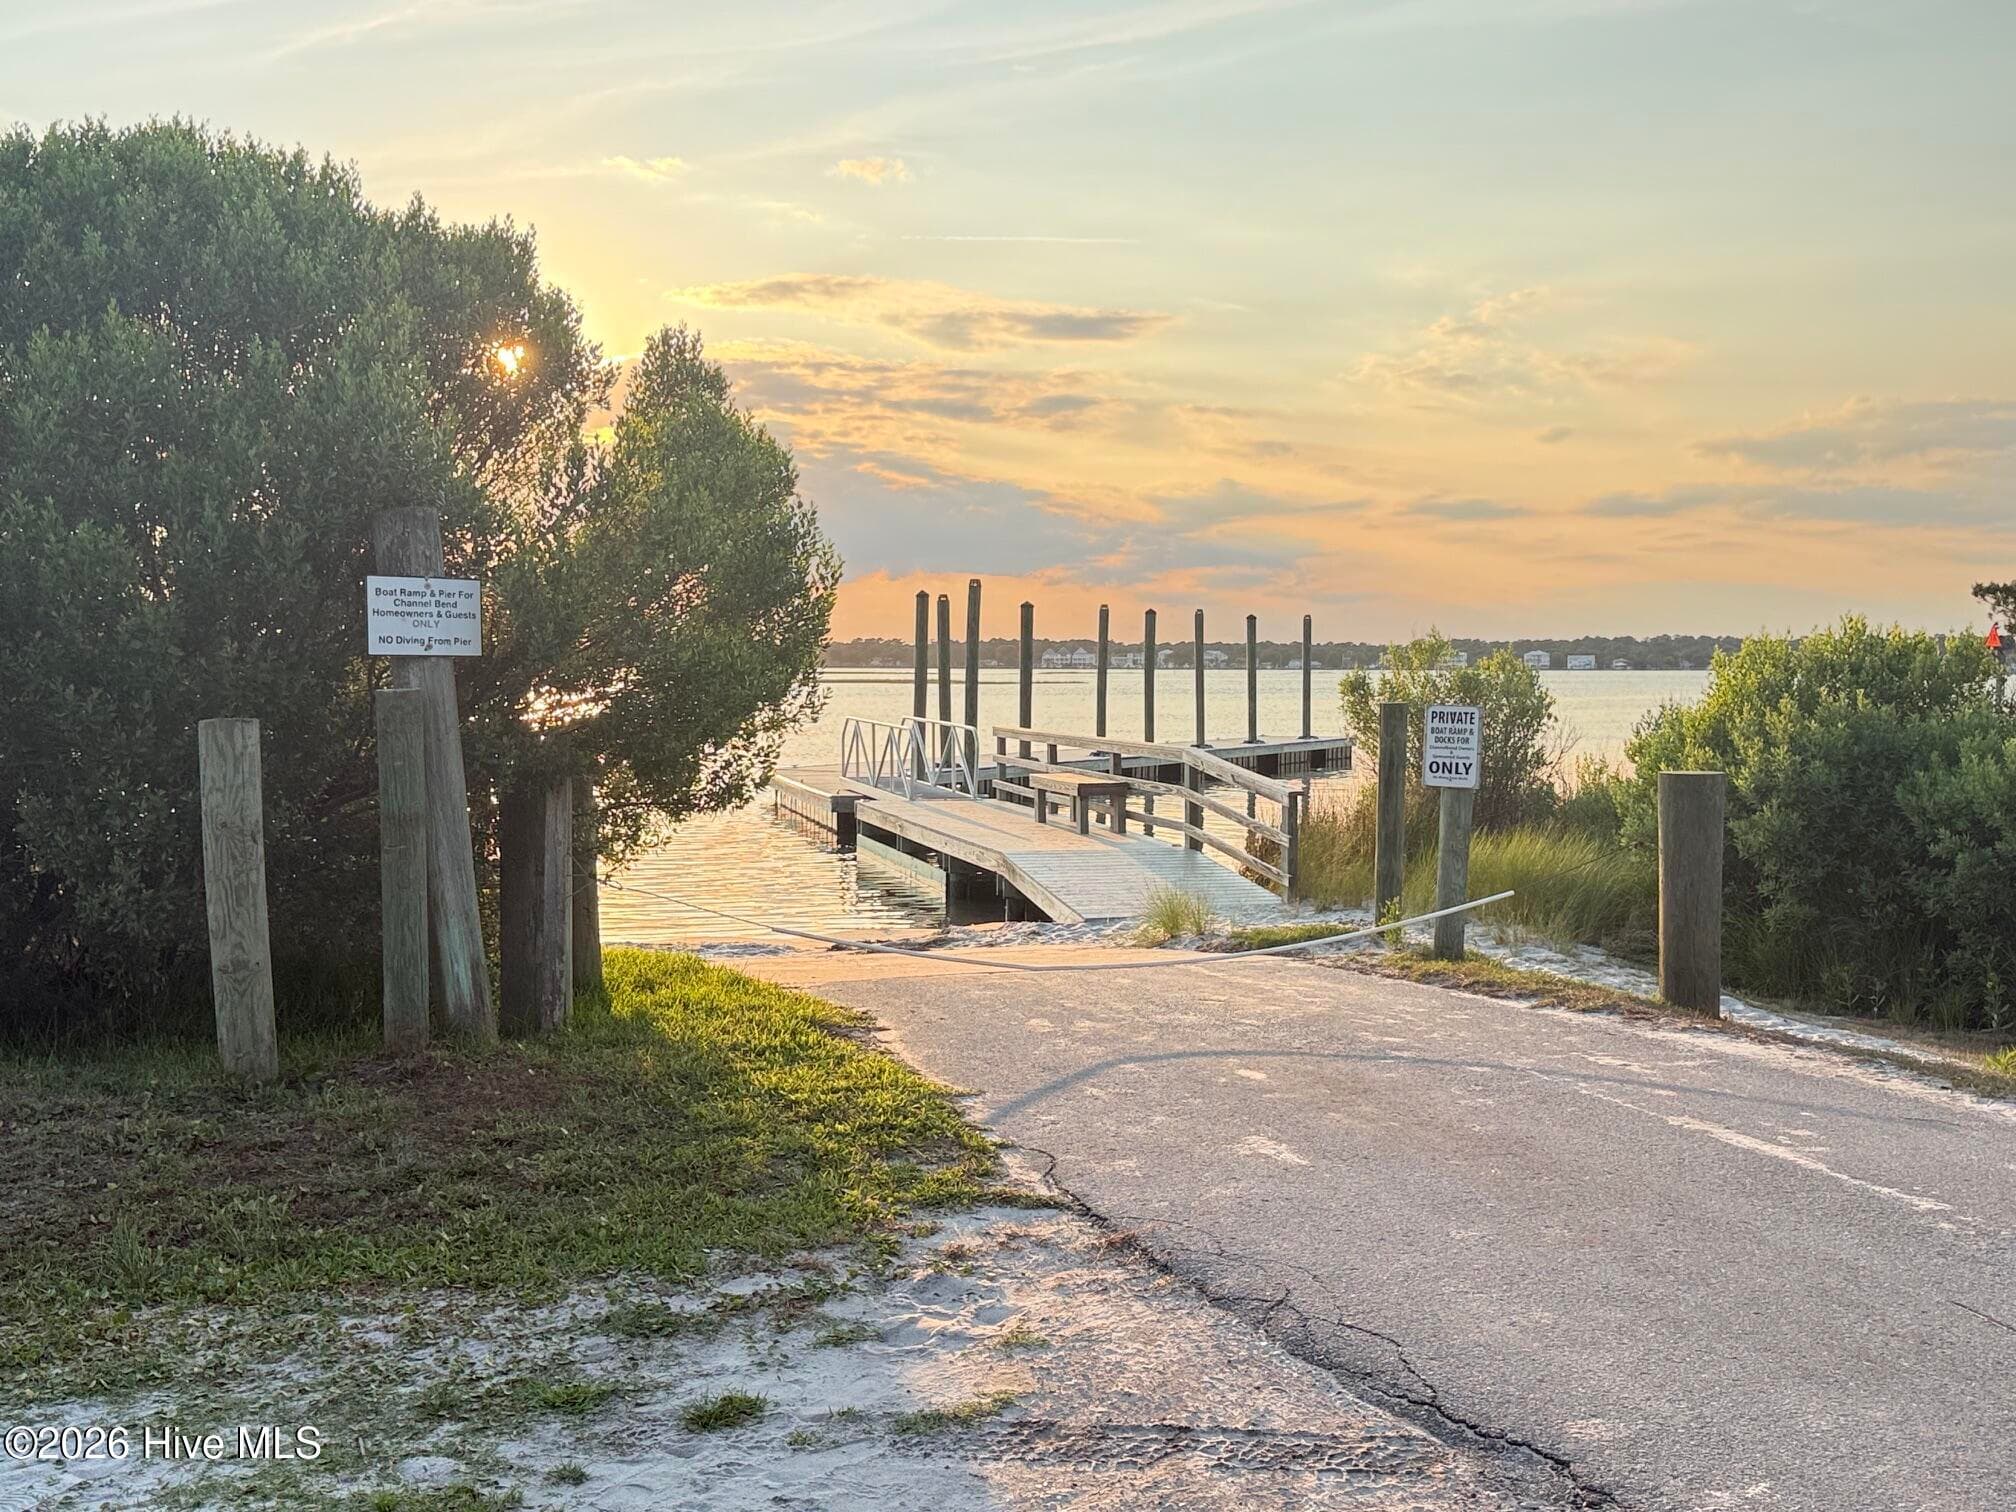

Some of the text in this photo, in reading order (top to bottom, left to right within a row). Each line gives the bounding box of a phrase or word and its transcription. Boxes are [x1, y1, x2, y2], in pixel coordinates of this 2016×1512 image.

[375, 587, 474, 599] Boat Ramp & Pier For
[393, 598, 458, 609] Channel Bend
[372, 608, 477, 620] Homeowners & Guests
[412, 620, 440, 629] ONLY
[378, 636, 472, 646] NO Diving From Pier
[1431, 711, 1476, 725] PRIVATE
[1431, 727, 1447, 735] BOAT
[1449, 728, 1468, 736] RAMP
[1434, 736, 1470, 745] DOCKS FOR
[1429, 761, 1473, 775] ONLY
